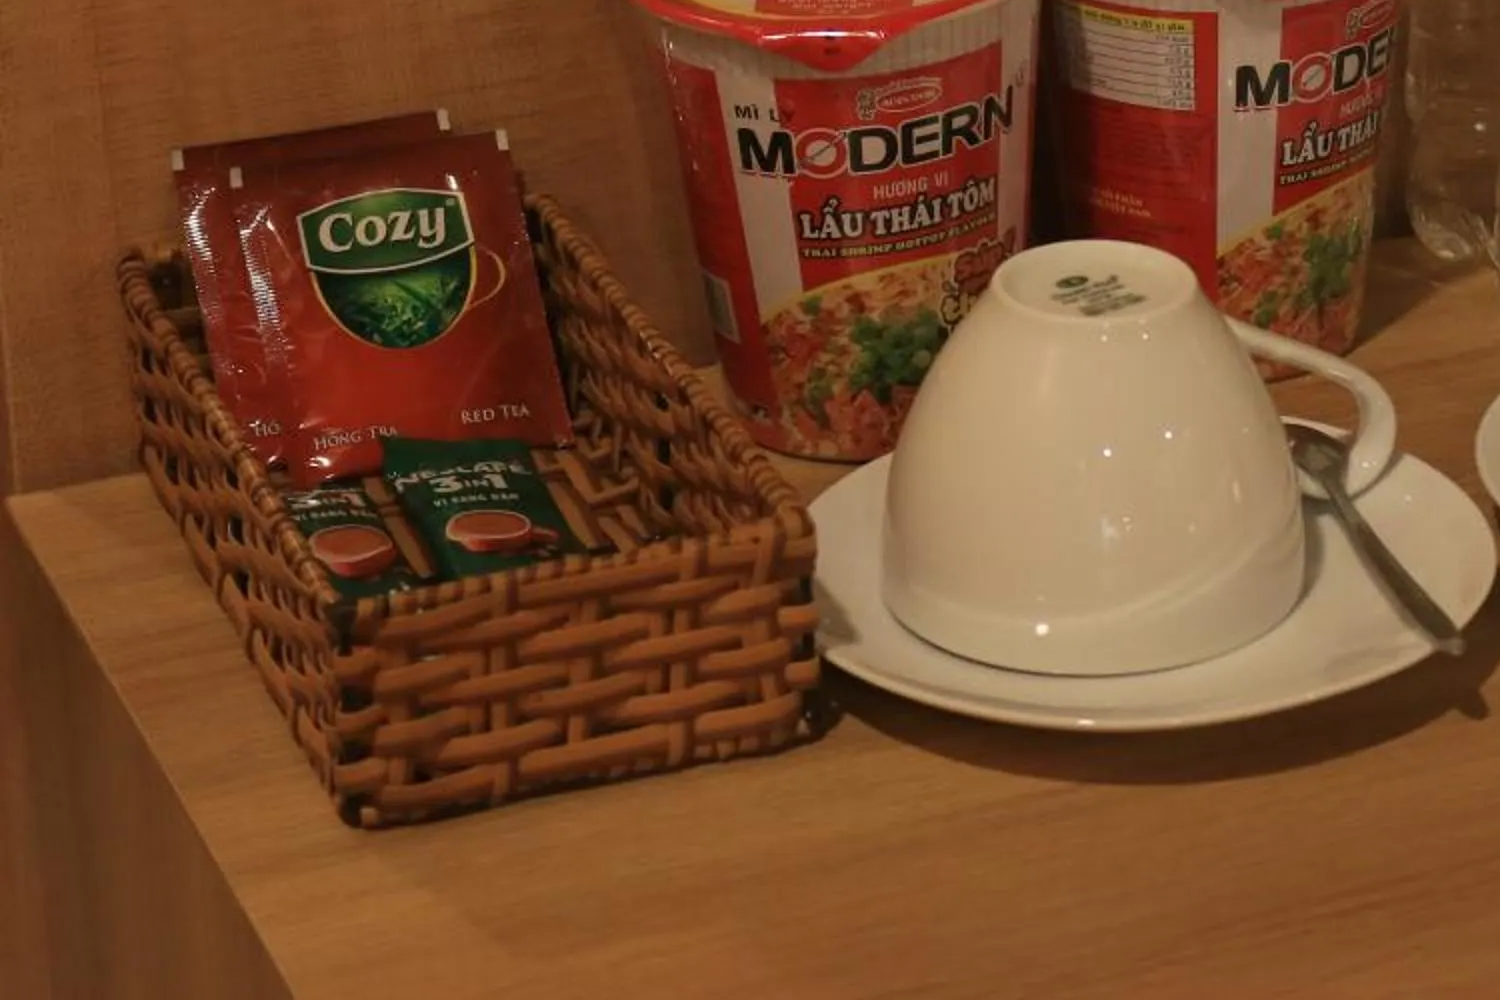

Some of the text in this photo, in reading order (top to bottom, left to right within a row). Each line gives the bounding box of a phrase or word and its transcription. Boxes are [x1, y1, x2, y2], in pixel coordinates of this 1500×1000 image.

[1234, 25, 1395, 108] MODE
[736, 84, 1014, 180] MODERN
[318, 207, 446, 253] Cozy
[799, 177, 996, 240] LẨU THÁI TÔM
[460, 404, 531, 425] RED TEA
